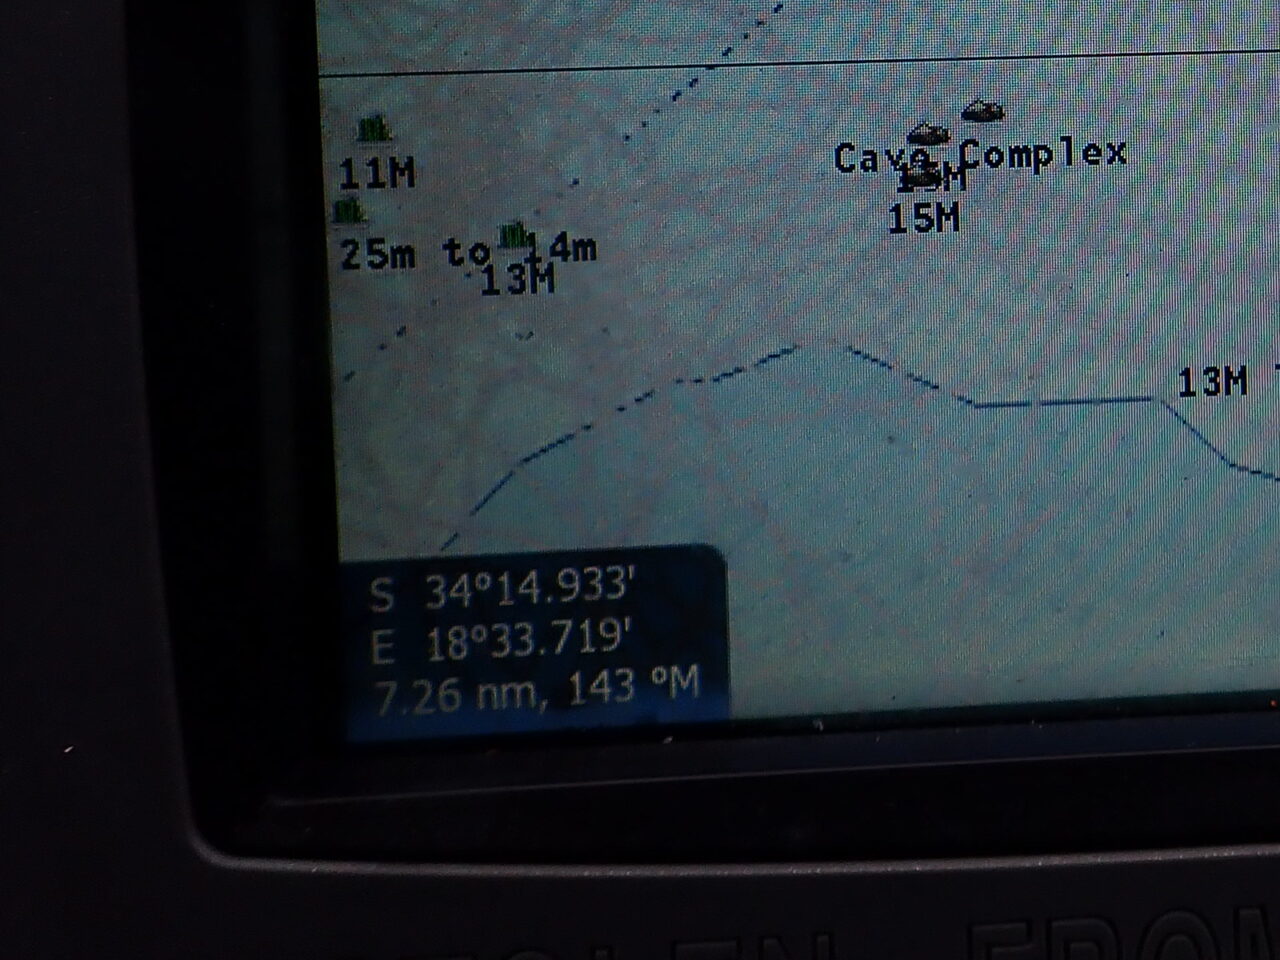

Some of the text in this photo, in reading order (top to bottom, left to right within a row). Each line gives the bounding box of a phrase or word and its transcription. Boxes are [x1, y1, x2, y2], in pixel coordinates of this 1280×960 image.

[339, 155, 415, 190] 11M
[959, 135, 1127, 175] Complex
[888, 201, 960, 234] 15M
[339, 237, 416, 270] 25m
[442, 237, 490, 266] to
[481, 261, 555, 295] 13M
[1178, 365, 1247, 396] 13M
[367, 576, 396, 614] S
[369, 628, 398, 666] E
[374, 676, 466, 718] 7.26
[475, 680, 550, 716] nm,
[566, 666, 638, 706] 143
